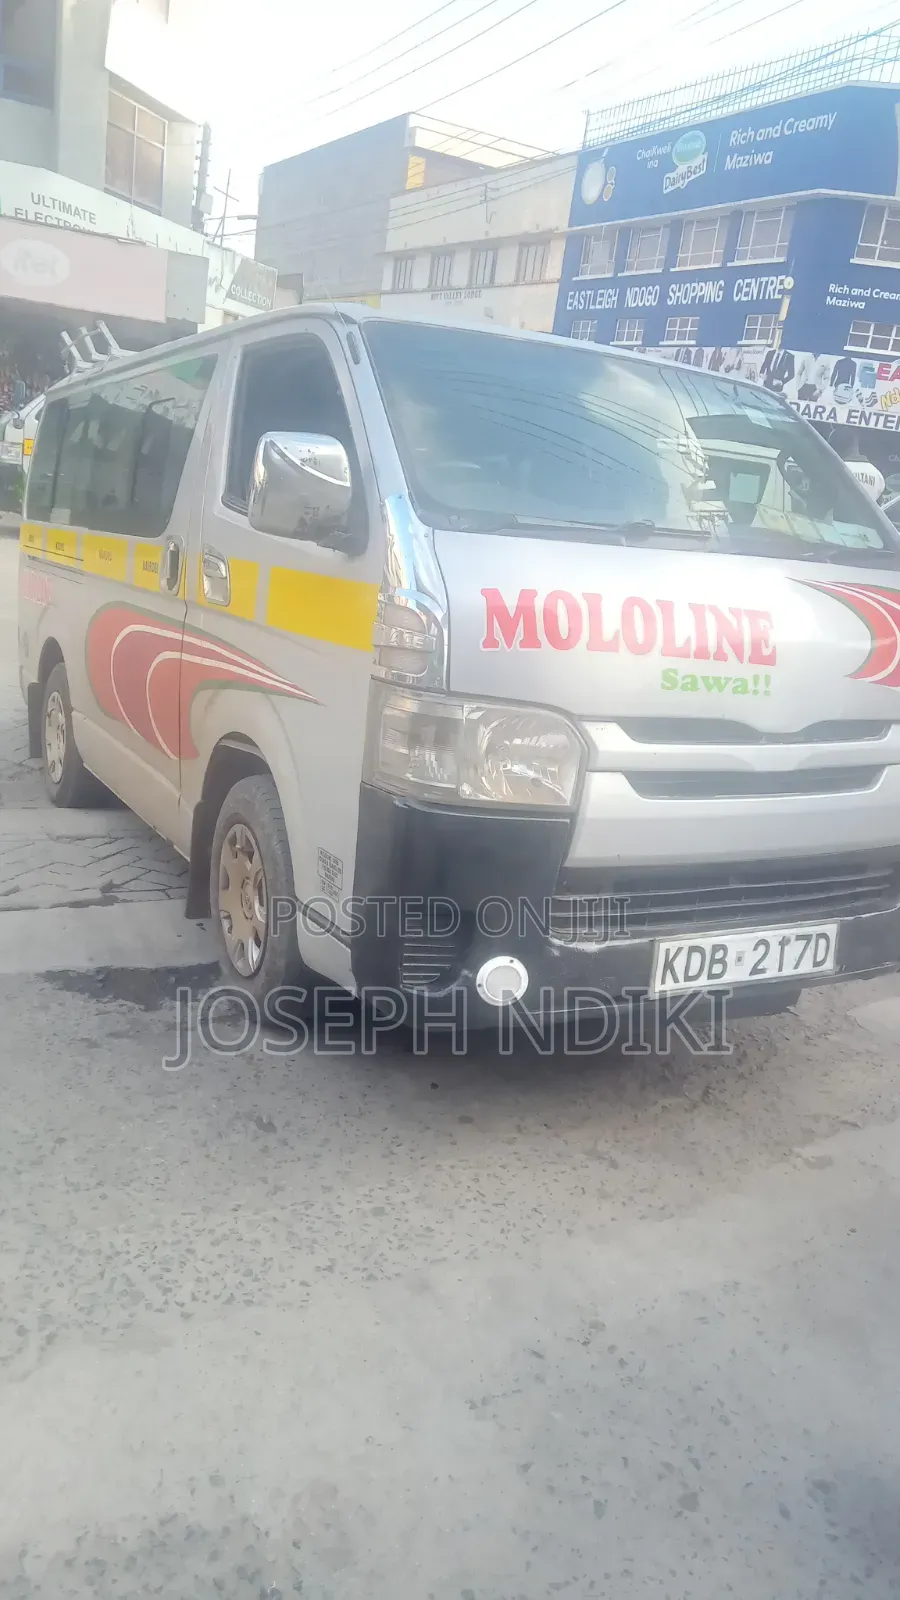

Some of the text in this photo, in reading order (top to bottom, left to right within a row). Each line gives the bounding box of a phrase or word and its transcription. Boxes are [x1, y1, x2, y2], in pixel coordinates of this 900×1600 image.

[729, 125, 754, 148] Rich
[756, 120, 780, 142] and
[783, 111, 838, 136] Creamy
[664, 159, 706, 191] DairyBest
[724, 148, 774, 171] Maziwa
[31, 191, 97, 226] ULTIMATE
[230, 284, 273, 309] COLLECTION
[566, 274, 786, 311] EASTLEIGH NDOGO SHOPPING CENTRE
[825, 295, 866, 310] Maziwa
[828, 282, 850, 295] Rich
[851, 286, 872, 298] and
[480, 587, 777, 666] MOLOLINE
[660, 667, 772, 697] Sawa!!
[661, 931, 832, 986] KDB 217D
